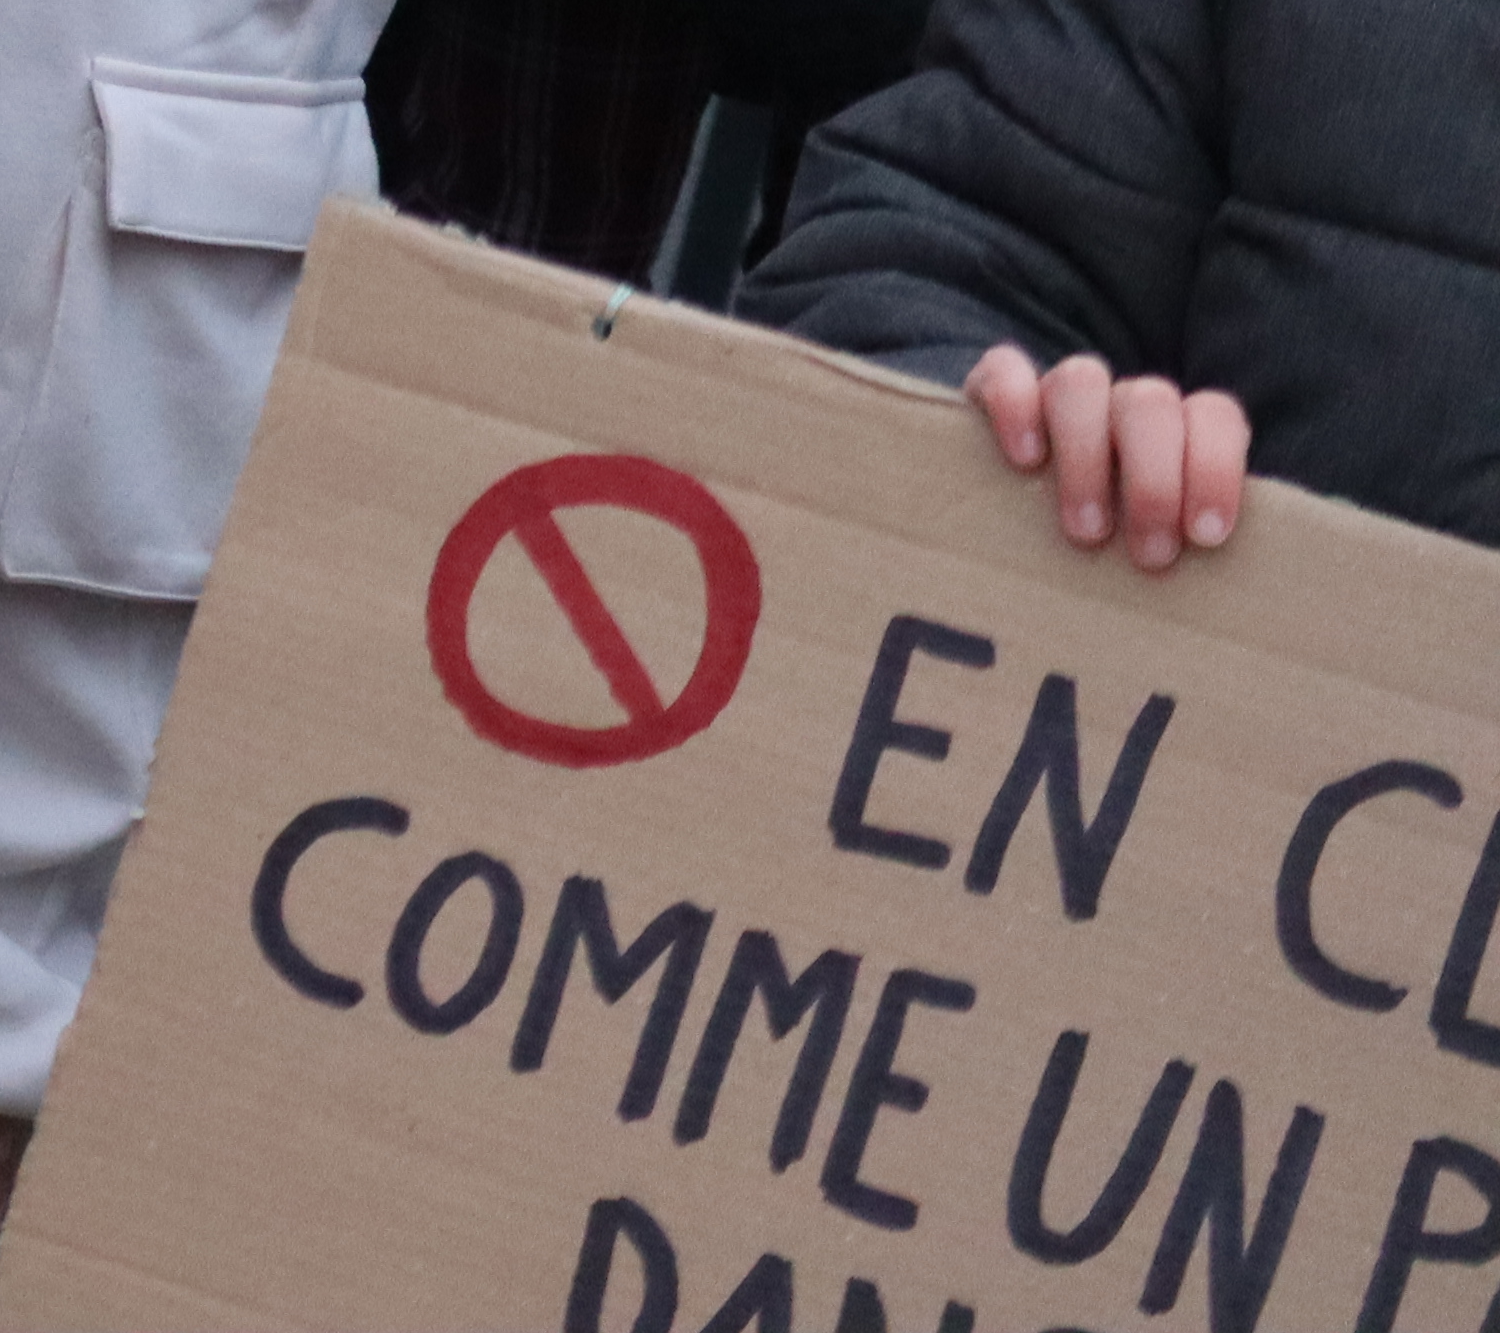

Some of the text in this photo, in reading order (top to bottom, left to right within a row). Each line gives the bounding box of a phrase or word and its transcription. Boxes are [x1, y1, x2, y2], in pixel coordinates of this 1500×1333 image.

[827, 614, 1174, 921] EN
[251, 795, 975, 1230] COMME
[1005, 1029, 1325, 1333] UN
